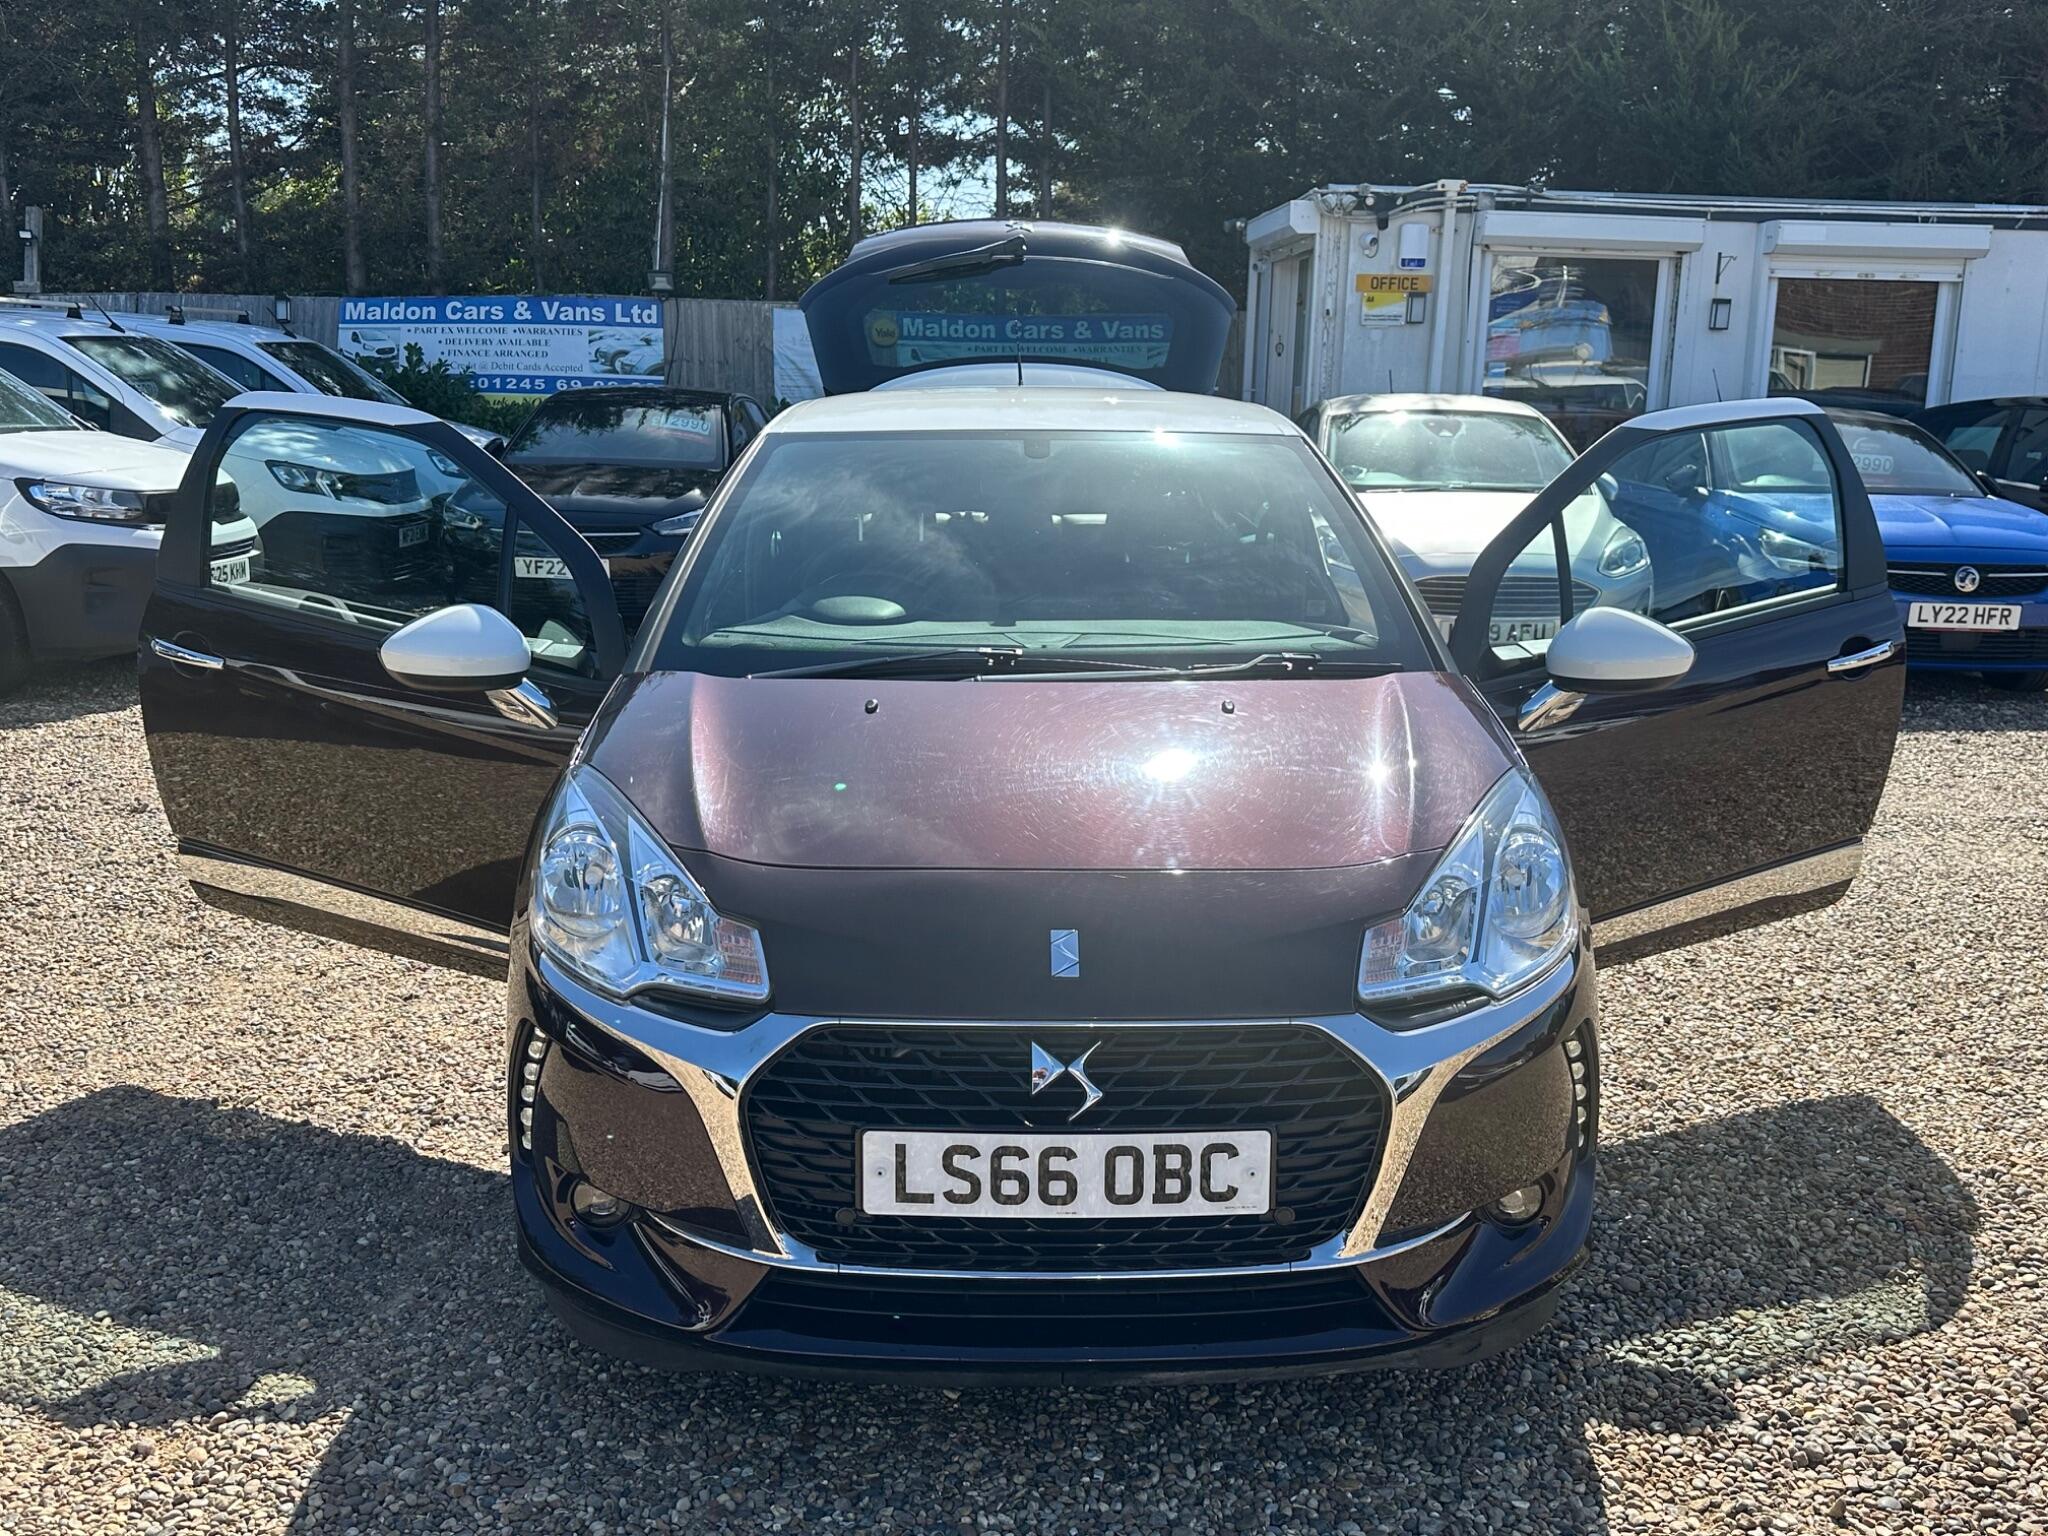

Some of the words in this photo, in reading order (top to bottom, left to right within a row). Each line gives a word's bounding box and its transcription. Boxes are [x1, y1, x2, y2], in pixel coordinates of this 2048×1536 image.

[1370, 276, 1420, 291] OFFICE
[345, 301, 436, 321] Maldon
[445, 301, 504, 321] Cars
[513, 301, 533, 321] &
[541, 301, 606, 322] Vans
[615, 303, 658, 324] Ltd
[414, 326, 438, 335] PART
[456, 326, 508, 336] WELCOME
[902, 317, 996, 339] Maldon
[1005, 319, 1064, 340] Cars
[1074, 320, 1092, 339] &
[1101, 320, 1165, 339] Vans
[445, 338, 494, 346] DELIVERY
[498, 338, 551, 348] AVAILABLE
[447, 349, 490, 358] FINANCE
[494, 350, 549, 359] ARRANGED
[490, 361, 514, 372] Debit
[516, 363, 541, 372] Cards
[545, 364, 583, 374] Accepted
[1853, 455, 1892, 473] 2990
[523, 559, 567, 576] YF22
[1918, 606, 1968, 624] LY22
[1973, 606, 2013, 625] HFR
[895, 1143, 1078, 1206] LS66
[1104, 1142, 1240, 1206] OBC
